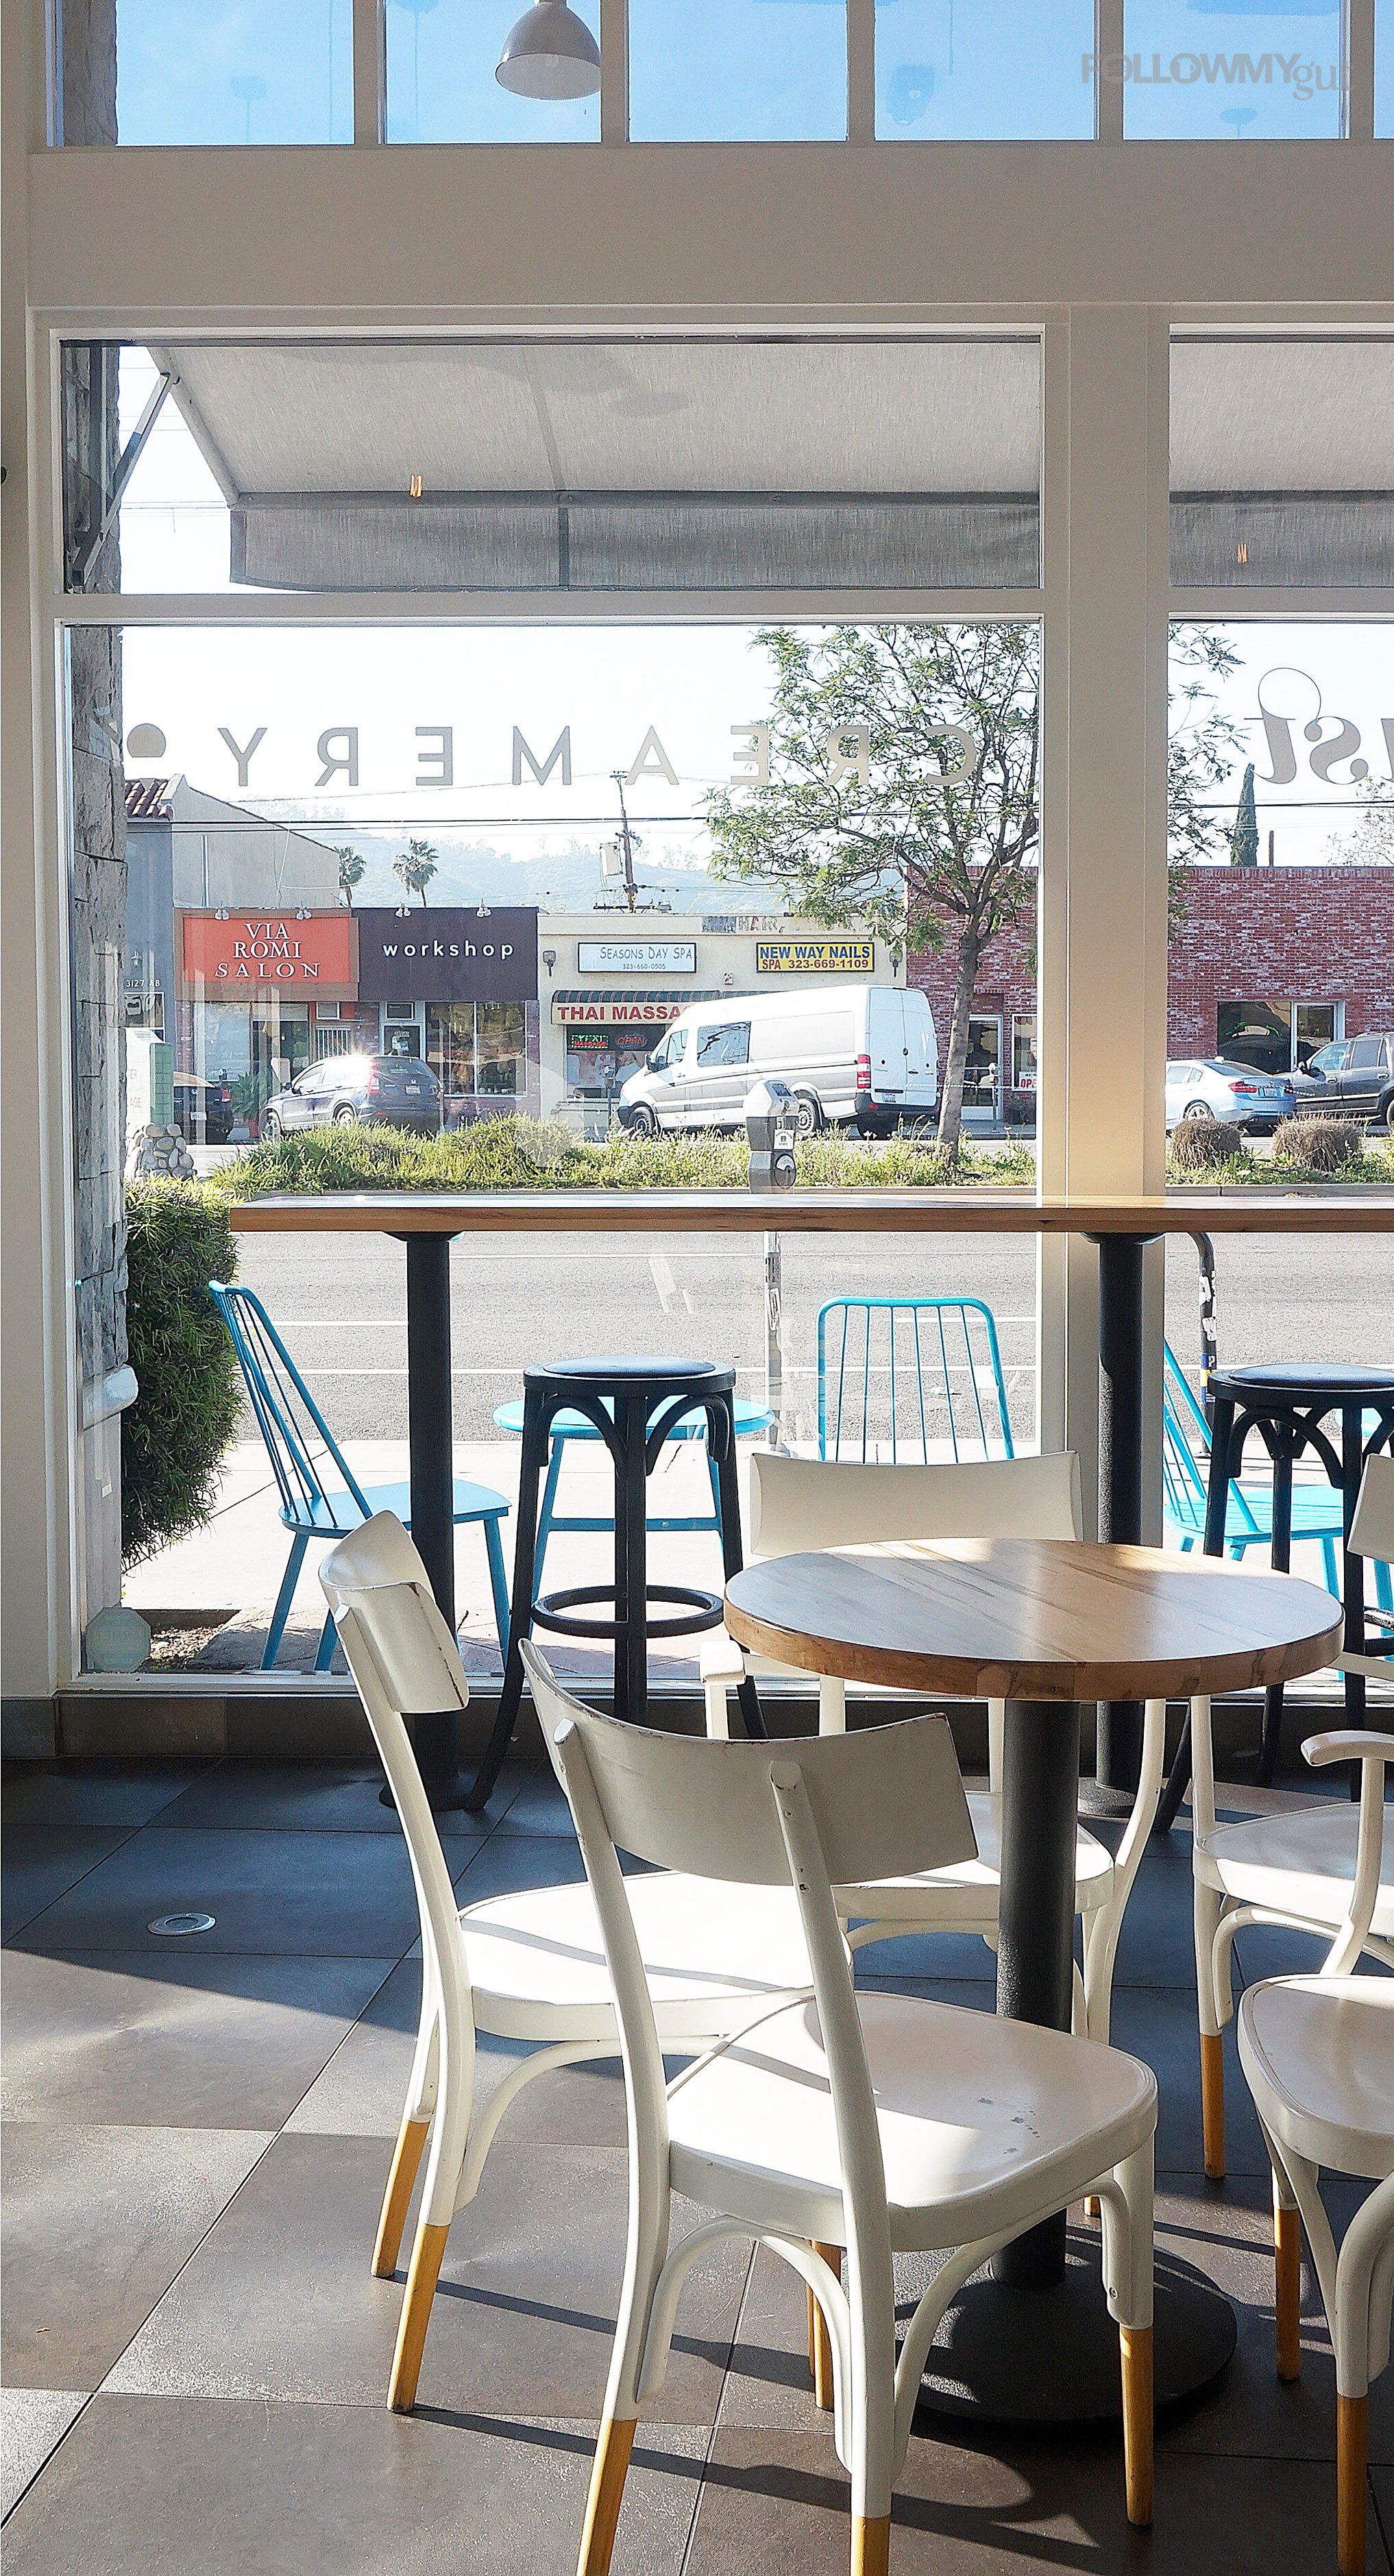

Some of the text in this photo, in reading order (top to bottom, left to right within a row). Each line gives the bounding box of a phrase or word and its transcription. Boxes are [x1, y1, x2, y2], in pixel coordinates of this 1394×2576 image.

[243, 923, 290, 939] VIA
[232, 941, 302, 958] ROMI
[382, 939, 514, 960] workshop
[600, 946, 692, 959] SEASONS DAY SPA
[760, 945, 870, 959] NEW WAY NAILS
[215, 963, 321, 978] SALON
[762, 959, 869, 969] SPA 323-669-1109
[125, 979, 160, 987] 3127 AB
[557, 1006, 689, 1020] THAI MASSA
[617, 1036, 645, 1045] OPEN
